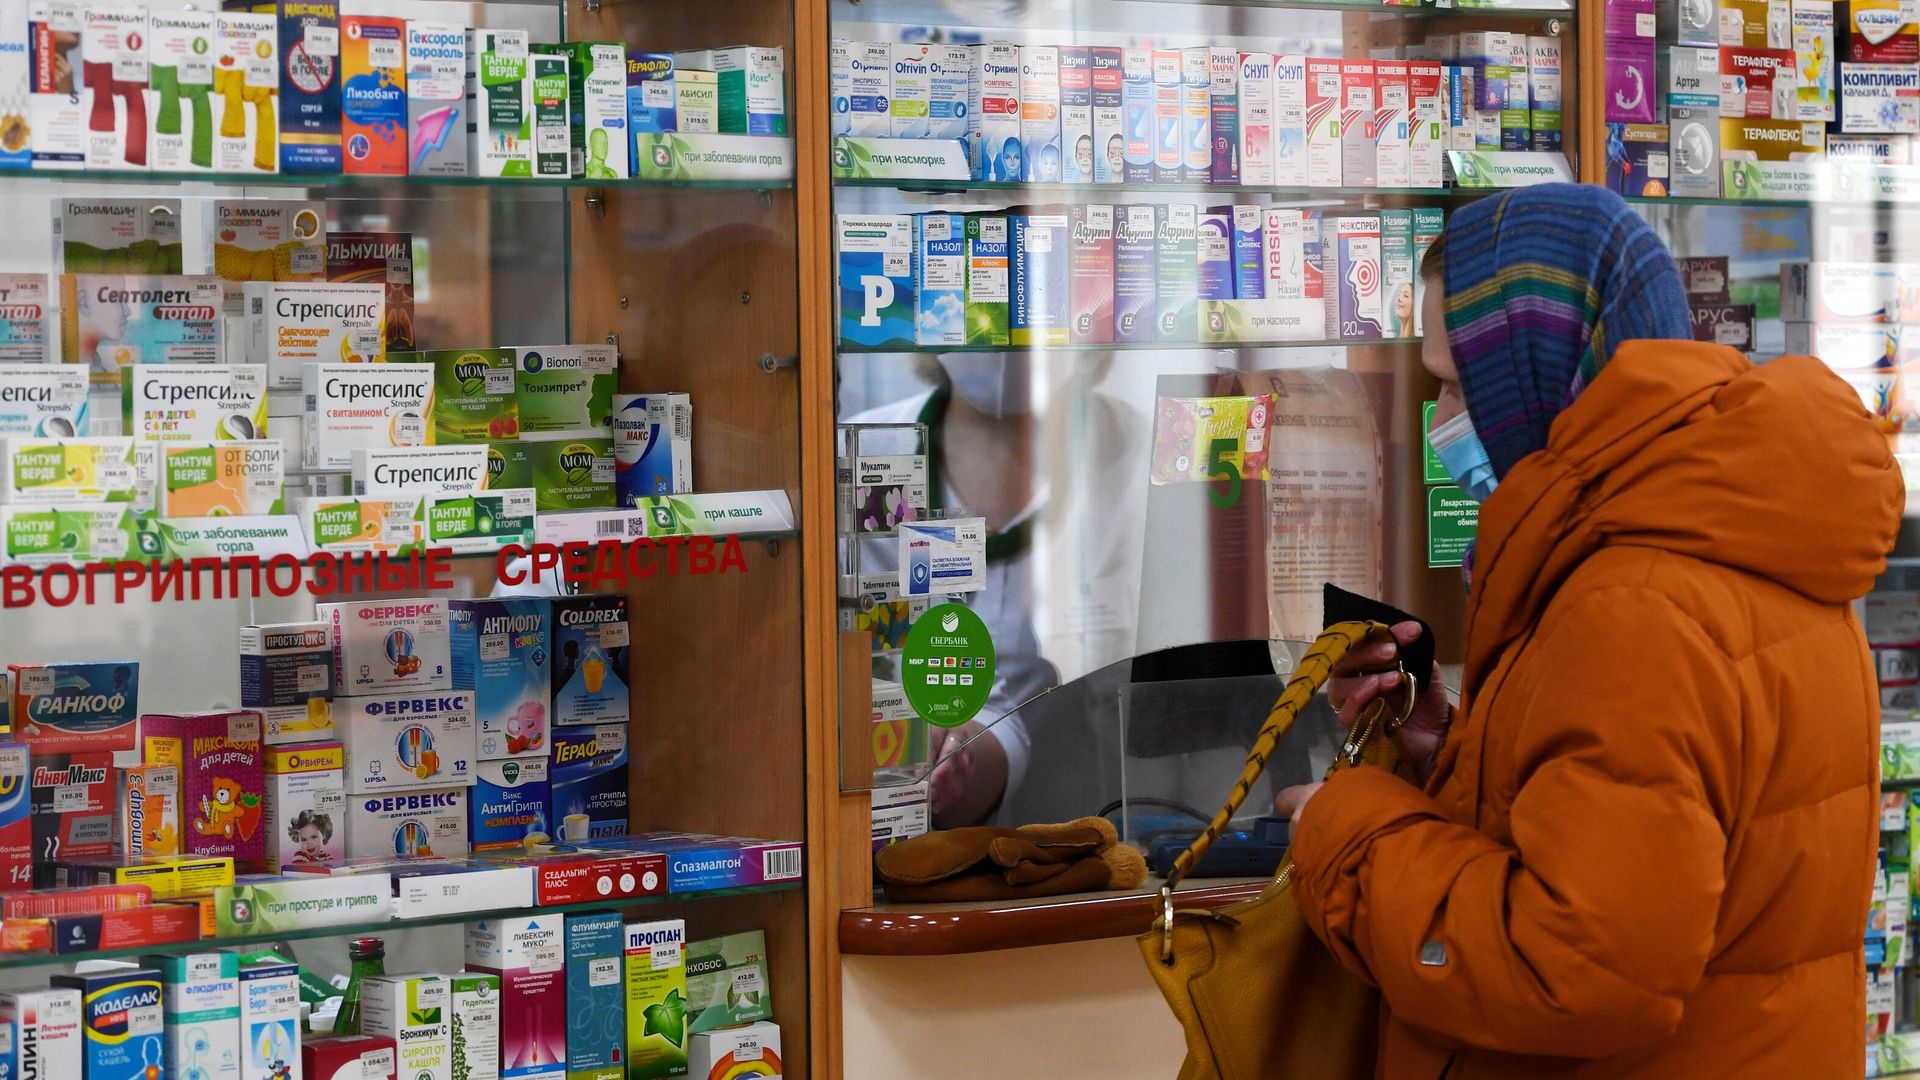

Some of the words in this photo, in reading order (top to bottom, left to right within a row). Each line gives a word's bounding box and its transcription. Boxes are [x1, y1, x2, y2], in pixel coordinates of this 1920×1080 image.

[409, 31, 464, 46] Гексорал
[410, 47, 464, 60] аэрозоль
[1212, 54, 1236, 63] РИНО
[1535, 47, 1559, 58] АКВА
[484, 54, 523, 67] ТАНТУМ
[628, 59, 670, 74] ТЕРАФЛЮ
[1063, 55, 1086, 69] Тизин
[1094, 56, 1118, 70] Тизин
[1534, 57, 1559, 66] МАРИС
[1732, 55, 1782, 68] ТЕРАФЛЕКС
[488, 65, 519, 78] ВЕРДЕ
[895, 61, 927, 75] Otrivin
[984, 63, 1018, 76] Отривин
[1243, 64, 1270, 79] СНУП
[1277, 64, 1303, 80] СНУП
[535, 79, 566, 91] ТАНТУМ
[1676, 76, 1700, 89] Артра
[1844, 73, 1918, 86] КОМПЛИВИТ
[346, 87, 400, 99] Лизобакт
[538, 87, 562, 98] ВЕРДЕ
[588, 87, 603, 95] Тева
[680, 90, 713, 99] АБИСИЛ
[1743, 128, 1800, 142] ТЕРАФЛЕКС
[684, 151, 701, 163] при
[703, 152, 757, 164] заболевании
[759, 154, 782, 166] горла
[872, 154, 891, 166] при
[895, 154, 946, 166] насморке
[1494, 166, 1511, 178] при
[1512, 165, 1555, 177] насморке
[69, 203, 135, 217] Граммидин
[219, 206, 281, 217] Граммидин
[1383, 215, 1410, 227] Називин
[1415, 213, 1443, 225] Називин
[931, 243, 961, 252] НАЗОЛ
[976, 243, 1006, 253] НАЗОЛ
[1264, 215, 1281, 280] nasic
[1017, 221, 1025, 325] РИНОФЛУИМУЦИЛ
[276, 296, 376, 321] Стрепсилс
[342, 319, 372, 328] Strepsils
[1252, 316, 1263, 328] при
[1266, 315, 1301, 327] насморке
[326, 378, 425, 403] Стрепсилс
[524, 382, 581, 395] Тонзипрет
[37, 403, 71, 412] Strepsils
[217, 401, 250, 410] Strepsils
[391, 399, 421, 408] Strepsils
[145, 411, 164, 419] ДЛЯ
[167, 409, 196, 419] ДЕТЕЙ
[333, 409, 383, 419] витамином
[144, 422, 150, 431] С
[161, 421, 179, 431] ЛЕТ
[523, 422, 534, 430] 50
[614, 418, 645, 430] Лазолван
[626, 430, 649, 441] МАКС
[16, 455, 62, 467] ТАНТУМ
[168, 456, 213, 468] ТАНТУМ
[224, 451, 241, 462] ОТ
[244, 449, 280, 461] БОЛИ
[860, 462, 891, 471] Мукалтин
[1207, 437, 1241, 509] 5
[21, 467, 56, 481] ВЕРДЕ
[174, 468, 207, 481] ВЕРДЕ
[375, 463, 478, 487] Стрепсилс
[442, 482, 474, 491] Strepsils
[658, 483, 667, 491] 24
[316, 510, 358, 522] ТАНТУМ
[431, 506, 472, 519] ТАНТУМ
[704, 508, 726, 521] при
[729, 506, 763, 518] кашле
[9, 520, 55, 532] ТАНТУМ
[321, 523, 353, 536] ВЕРДЕ
[436, 520, 467, 532] ВЕРДЕ
[15, 533, 49, 547] ВЕРДЕ
[174, 528, 200, 540] при
[203, 527, 288, 540] заболевании
[216, 540, 254, 553] горла
[1, 547, 454, 608] ВОГРИППОЗНЫЕ
[496, 533, 748, 589] СРЕДСТВА
[358, 603, 435, 620] ФЕРВЕКС
[559, 608, 620, 627] COLDREX
[483, 613, 542, 636] АНТИФЛУ
[266, 630, 326, 649] ПРОСТУДОКС
[514, 631, 545, 649] КИДС
[931, 636, 968, 645] СБЕРБАНК
[332, 608, 344, 687] ФЕРВЕКС
[436, 665, 443, 675] 8
[37, 692, 126, 714] РАНКОФ
[365, 695, 464, 715] ФЕРВЕКС
[270, 723, 277, 732] 5
[482, 720, 488, 730] 5
[200, 752, 222, 770] для
[222, 749, 254, 766] детей
[288, 755, 334, 768] ОРВИРЕМ
[454, 759, 466, 771] 12
[32, 766, 107, 787] АнвиМакс
[504, 768, 518, 776] VICKS
[364, 776, 387, 784] UPSA
[502, 791, 521, 800] Викс
[364, 792, 457, 813] ФЕРВЕКС
[481, 800, 543, 815] АнтиГрипп
[484, 814, 538, 828] КОМПЛЕКС
[194, 844, 235, 855] Клубника
[674, 855, 742, 873] Спазмалгон
[10, 864, 30, 883] 14
[545, 868, 588, 880] СЕДАЛЬГИН
[545, 880, 568, 888] ПЛЮС
[268, 902, 287, 914] при
[290, 898, 334, 912] простуде
[346, 893, 378, 908] гриппе
[571, 920, 618, 931] ФЛУИМУЦИЛ
[513, 930, 554, 941] ЛИБЕКСИН
[630, 928, 681, 947] ПРОСПАН
[522, 939, 544, 948] МУКО
[745, 954, 759, 963] 375
[185, 981, 234, 994] ФЛЮДИТЕК
[94, 990, 158, 1015] КОДЕЛАК
[462, 999, 495, 1008] Геделикс
[110, 1014, 125, 1023] НЕО
[400, 1026, 439, 1041] Бронхикум
[441, 1025, 447, 1034] С
[402, 1046, 431, 1058] СИРОП
[434, 1045, 446, 1055] ОТ
[408, 1057, 441, 1069] КАШЛЯ
